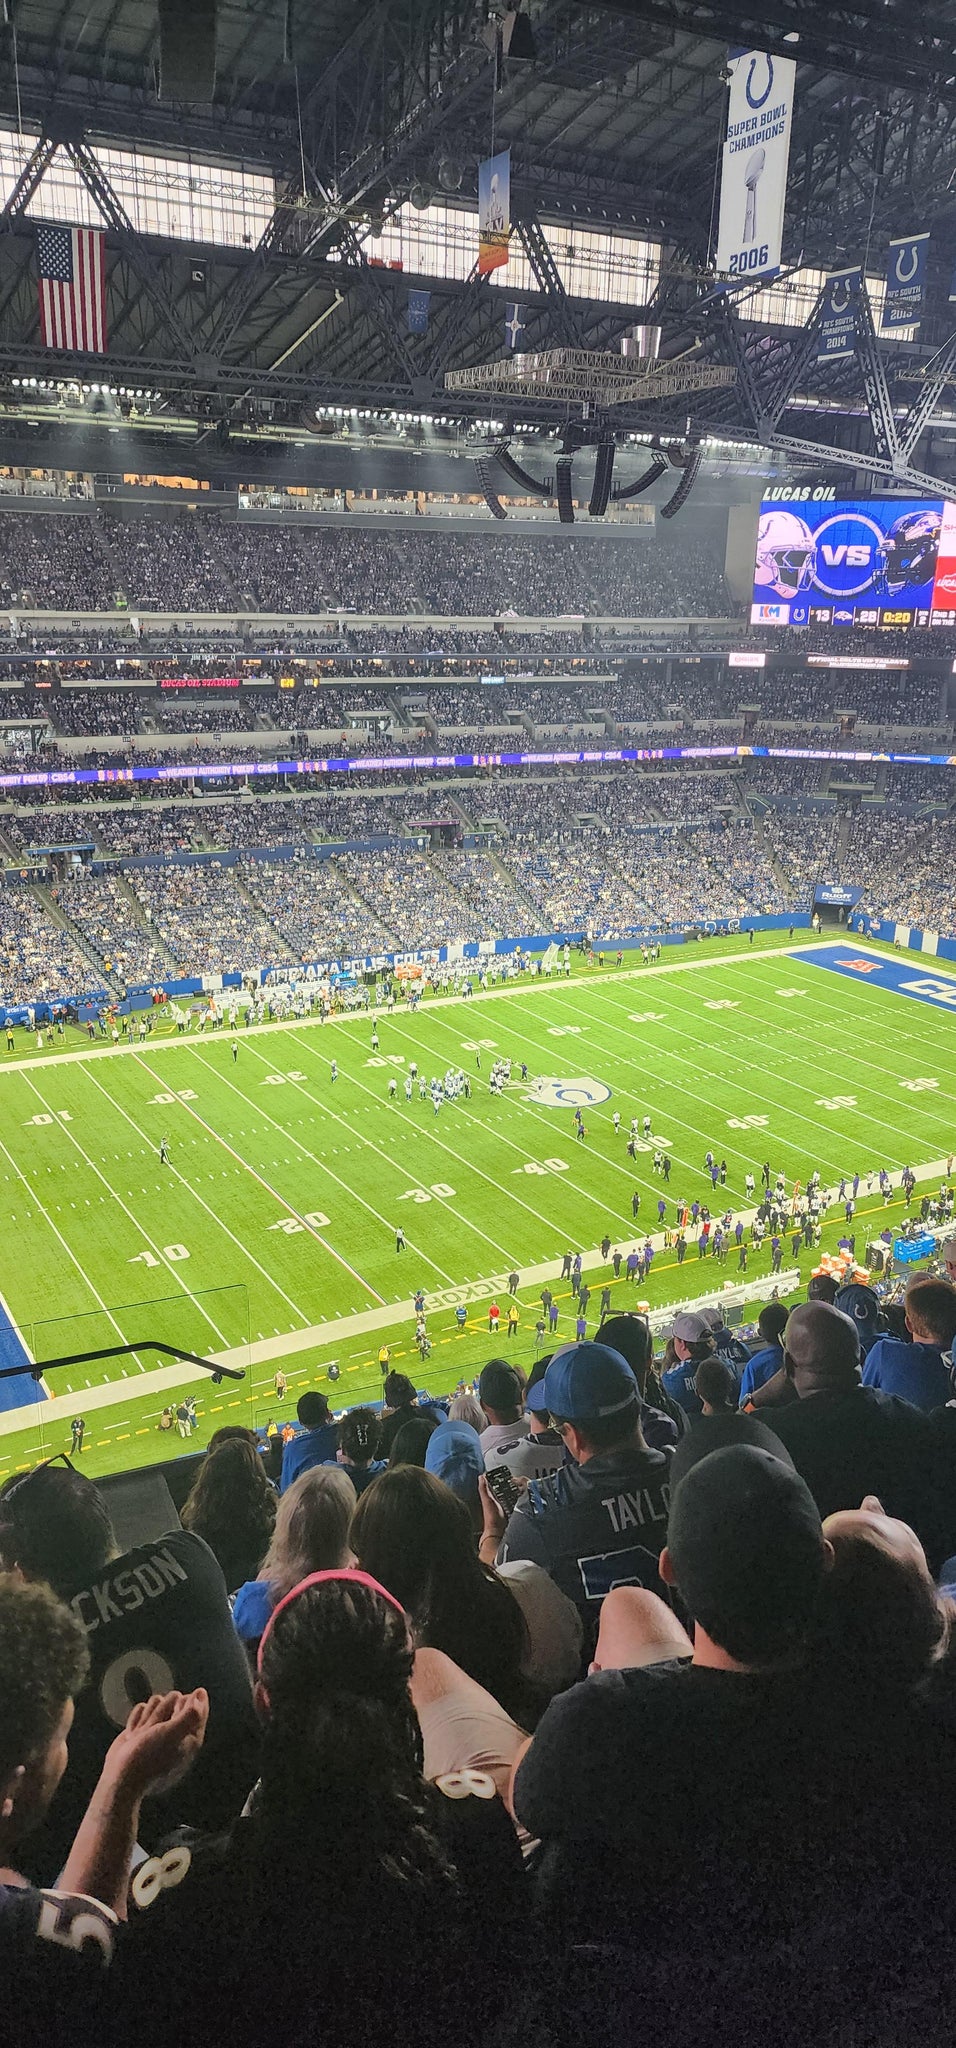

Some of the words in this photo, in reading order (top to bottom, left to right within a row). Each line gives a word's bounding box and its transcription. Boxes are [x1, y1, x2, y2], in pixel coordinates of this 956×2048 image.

[728, 116, 758, 138] SUPER
[759, 103, 787, 127] BOWL
[729, 120, 785, 153] CHAMPIONS
[729, 244, 769, 274] 2006
[899, 285, 921, 297] SOUTH
[834, 315, 854, 326] SOUTH
[821, 322, 855, 336] CHAMPIONS
[826, 335, 847, 349] 2014
[762, 486, 810, 501] LUCAS
[811, 486, 836, 501] OIL
[820, 545, 871, 566] VS
[815, 609, 830, 622] 13
[860, 610, 877, 623] 28
[883, 611, 910, 623] 0:20
[919, 616, 927, 625] 2
[160, 678, 187, 688] LUCAS
[187, 678, 201, 688] OIL
[201, 678, 240, 687] STADIUM
[166, 767, 198, 777] WEATHER
[198, 766, 231, 776] AUTHORITY
[821, 891, 852, 899] Ruoff
[265, 1071, 308, 1085] 30
[898, 1078, 939, 1092] 20
[154, 1089, 200, 1105] 20
[814, 1096, 856, 1110] 30
[32, 1110, 75, 1126] 10
[725, 1115, 768, 1130] 40
[628, 1134, 674, 1153] 50
[523, 1158, 570, 1176] 40
[403, 1183, 457, 1203] 30
[274, 1211, 332, 1235] 20
[139, 1243, 192, 1267] 10
[70, 1552, 189, 1634] CKSON
[132, 1847, 191, 1907] 8
[36, 1900, 113, 1967] 5
